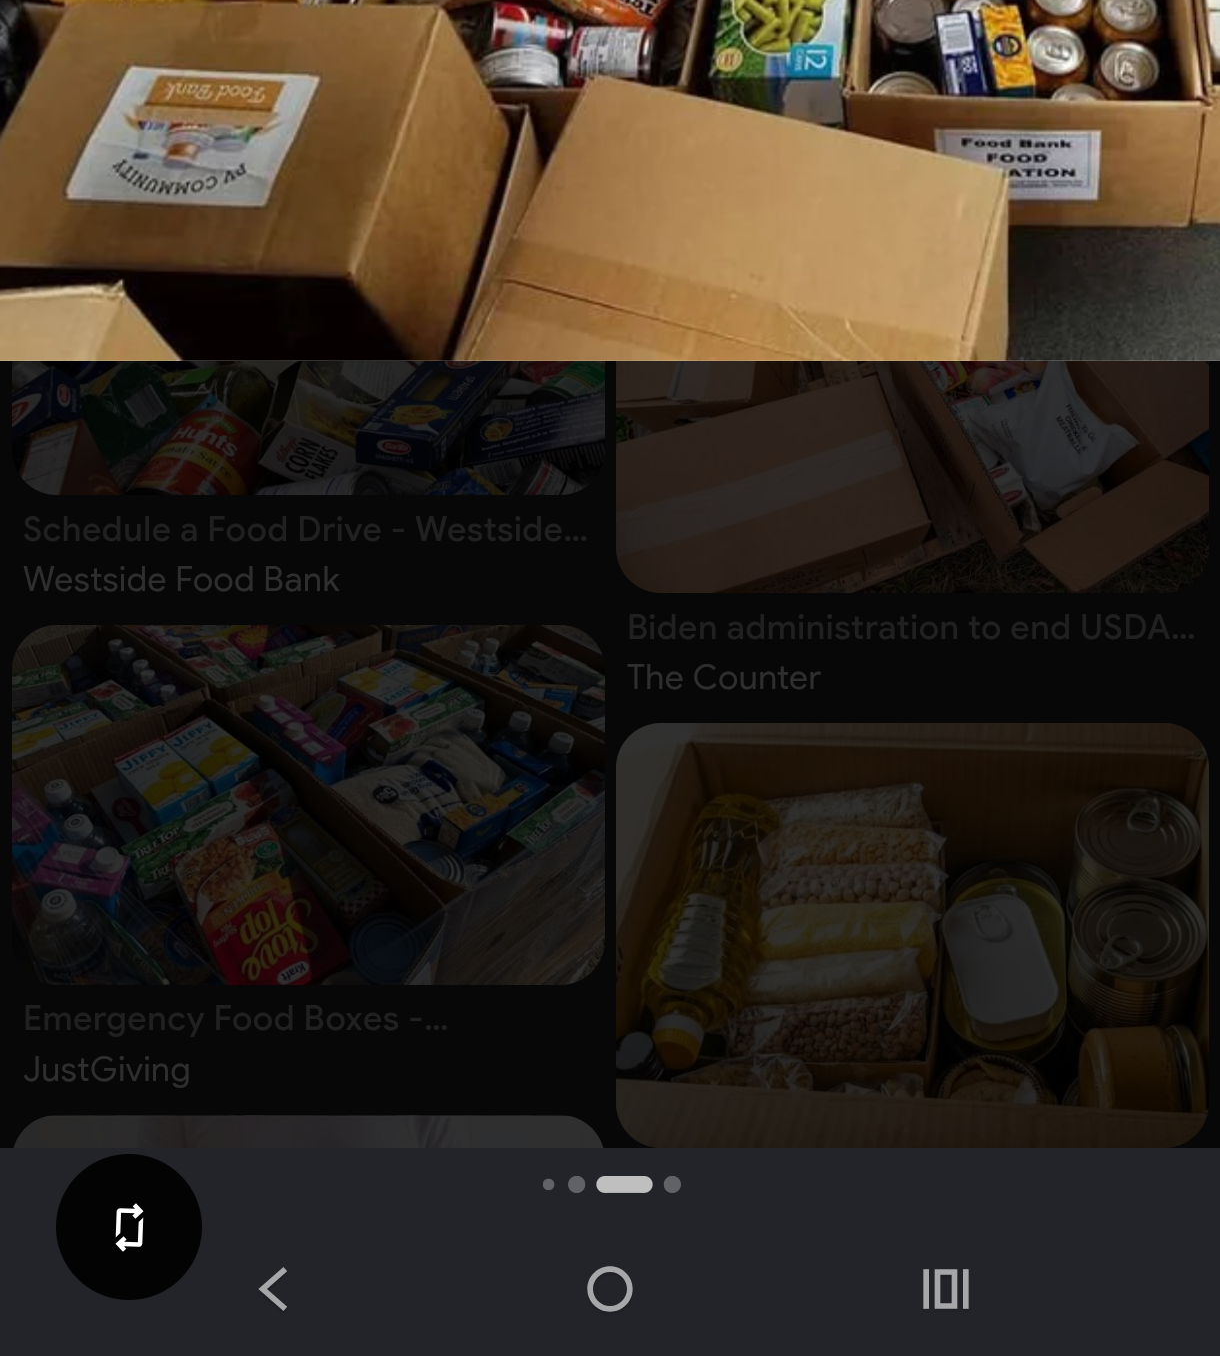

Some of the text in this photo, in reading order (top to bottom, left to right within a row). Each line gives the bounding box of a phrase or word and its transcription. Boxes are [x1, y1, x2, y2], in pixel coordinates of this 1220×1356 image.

[803, 48, 828, 71] 12
[166, 82, 266, 103] Food Bank
[960, 137, 1072, 149] Food Bank
[986, 153, 1048, 164] FOOD
[112, 159, 248, 195] PV COMMUNITY
[1008, 167, 1077, 178] ATION
[384, 441, 409, 452] Barilla
[1055, 415, 1081, 455] MEATBALLS
[156, 445, 194, 457] omato
[285, 437, 322, 474] CORN
[304, 445, 338, 480] FLAKES
[375, 453, 404, 462] SPAGHETTI
[23, 515, 171, 542] Schedule
[180, 523, 198, 542] a
[209, 515, 287, 542] Food
[299, 515, 382, 542] Drive
[22, 565, 340, 593] Westside Food Bank
[629, 613, 717, 640] Biden
[727, 613, 958, 640] administration
[968, 616, 1001, 640] to
[1010, 613, 1070, 640] end
[626, 663, 822, 691] The Counter
[173, 721, 213, 747] JIFFY
[122, 745, 167, 771] JIFFY
[133, 826, 180, 859] TREE TOP
[150, 863, 171, 880] TRE
[223, 880, 268, 916] CHICKEN
[239, 896, 280, 945] Top
[241, 898, 319, 981] Stove
[281, 963, 307, 982] Kraft
[25, 1004, 205, 1038] Emergency
[215, 1004, 293, 1031] Food
[305, 1004, 399, 1031] Boxes
[23, 1055, 190, 1089] JustGiving
